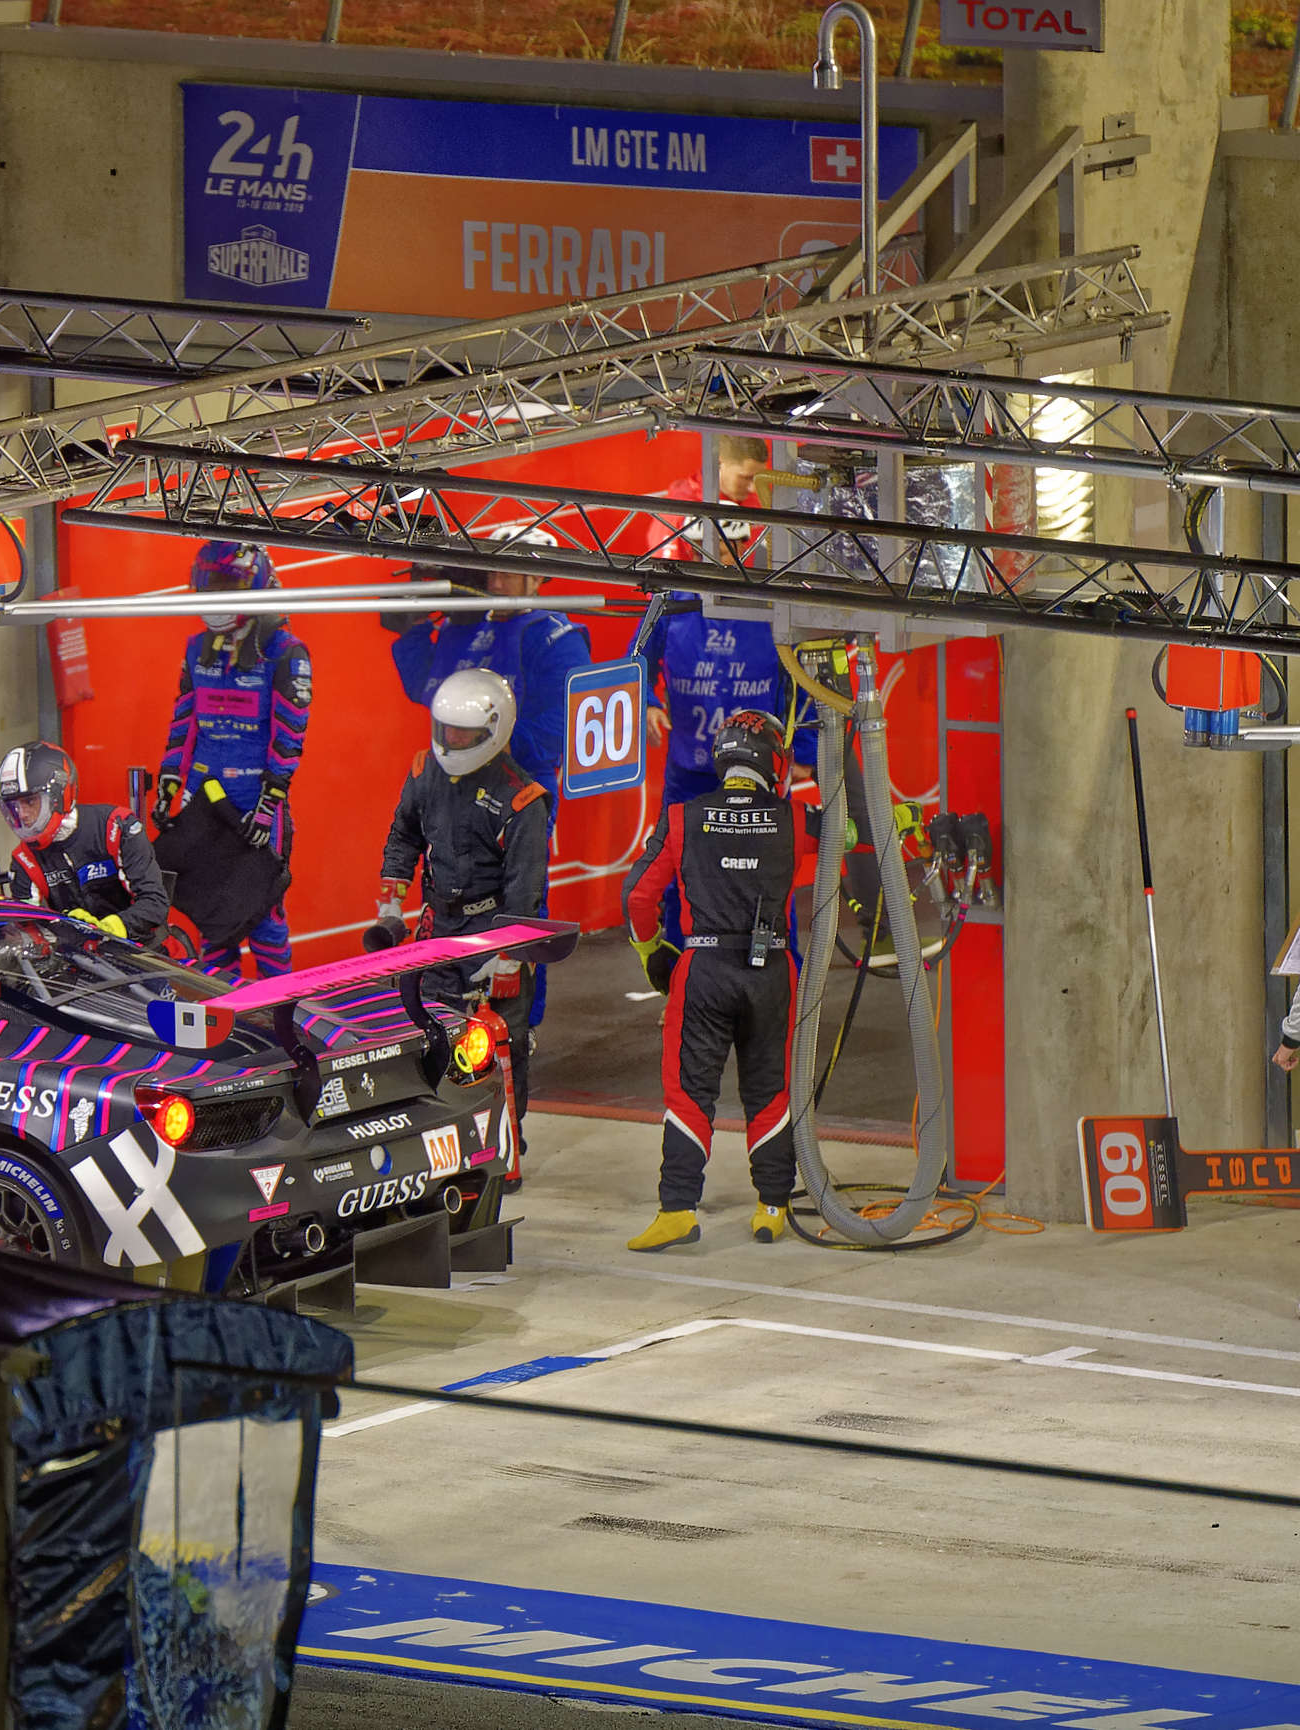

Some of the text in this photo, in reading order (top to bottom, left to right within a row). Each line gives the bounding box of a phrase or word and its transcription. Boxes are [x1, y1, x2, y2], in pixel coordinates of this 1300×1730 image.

[957, 0, 1087, 35] TOTAL
[208, 110, 314, 181] 24h
[571, 126, 707, 173] LM GTE AM
[204, 177, 308, 202] LE MANS
[209, 241, 309, 285] SUPERFINALE
[462, 220, 666, 298] FERRARI
[728, 661, 746, 678] TV
[732, 678, 773, 697] TRACK
[574, 689, 634, 768] 60
[708, 810, 772, 823] KESSEL
[721, 857, 759, 870] CREW
[332, 1044, 402, 1071] KESSEL RACING
[347, 1113, 413, 1140] HUBLOT
[429, 1133, 458, 1171] AM
[1100, 1131, 1147, 1216] 60
[337, 1170, 431, 1218] GUESS
[326, 1616, 1300, 1730] MICHEL
